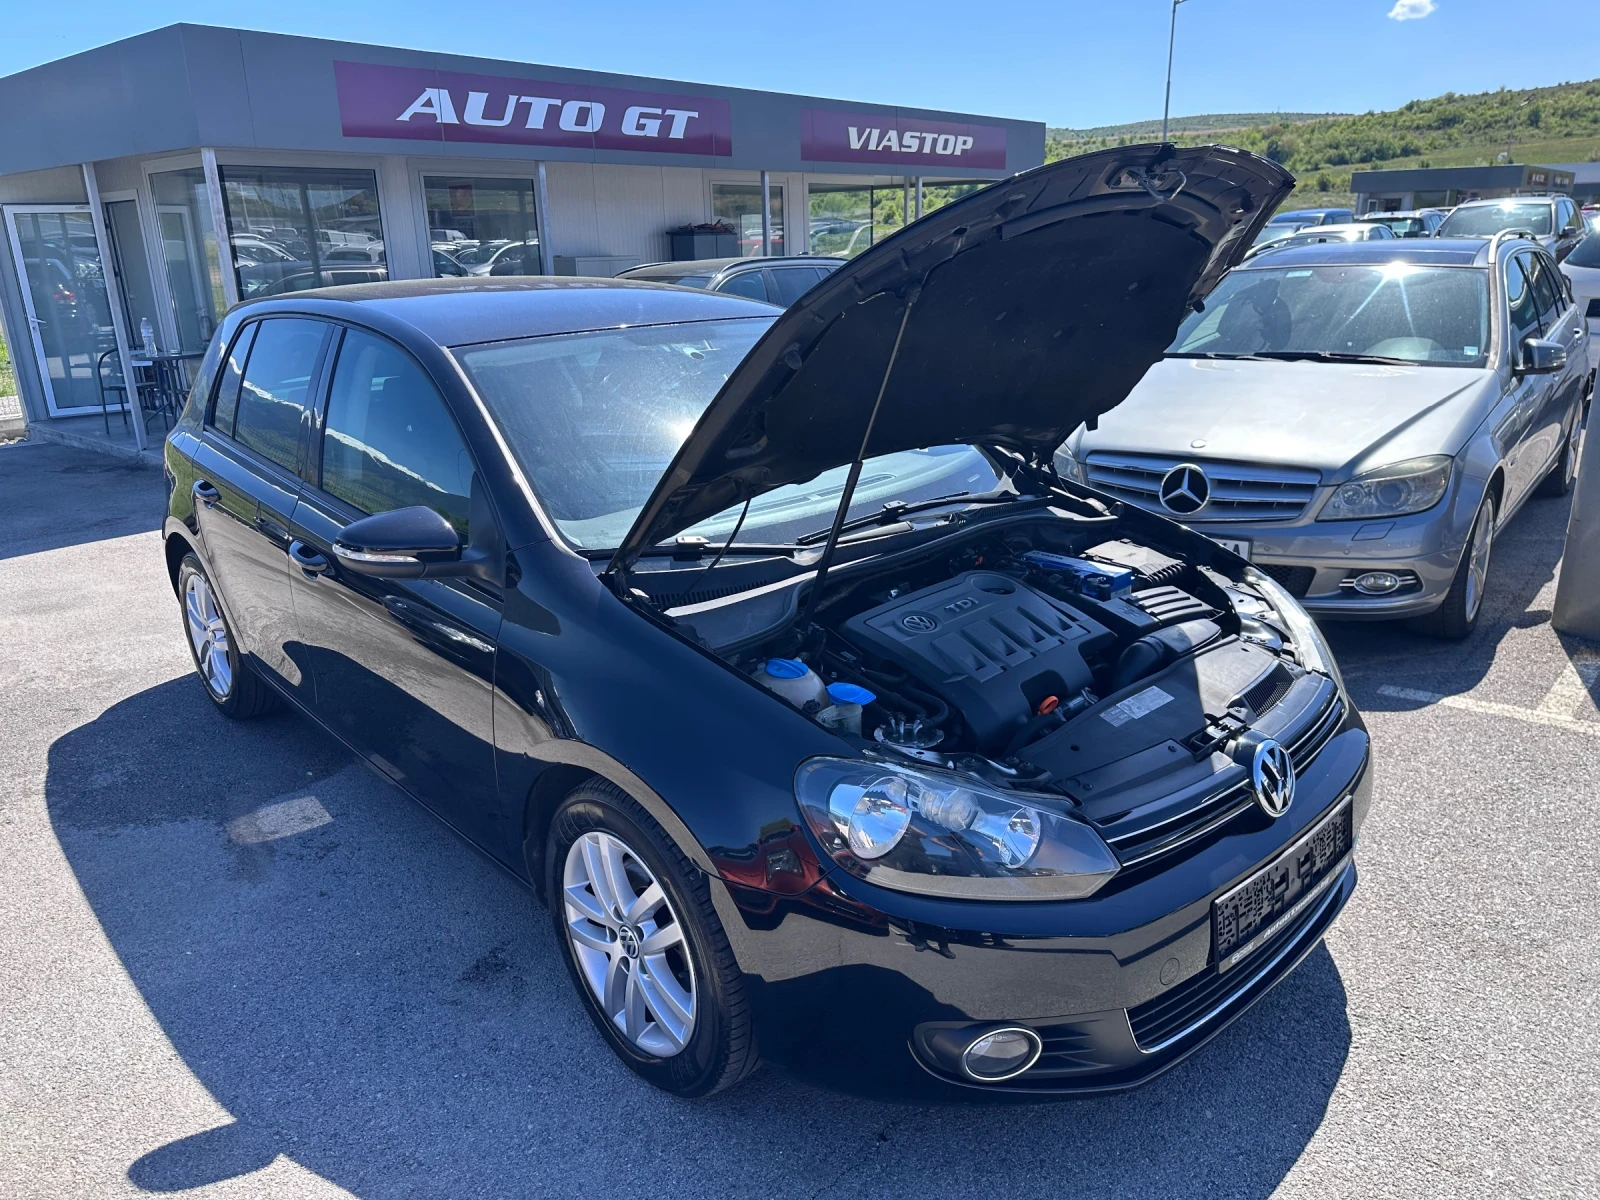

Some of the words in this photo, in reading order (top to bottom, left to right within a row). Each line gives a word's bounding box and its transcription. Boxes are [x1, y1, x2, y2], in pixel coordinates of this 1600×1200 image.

[396, 87, 606, 133] AUTO
[621, 106, 698, 139] GT
[847, 126, 974, 155] VIASTOP
[944, 596, 979, 612] TDI
